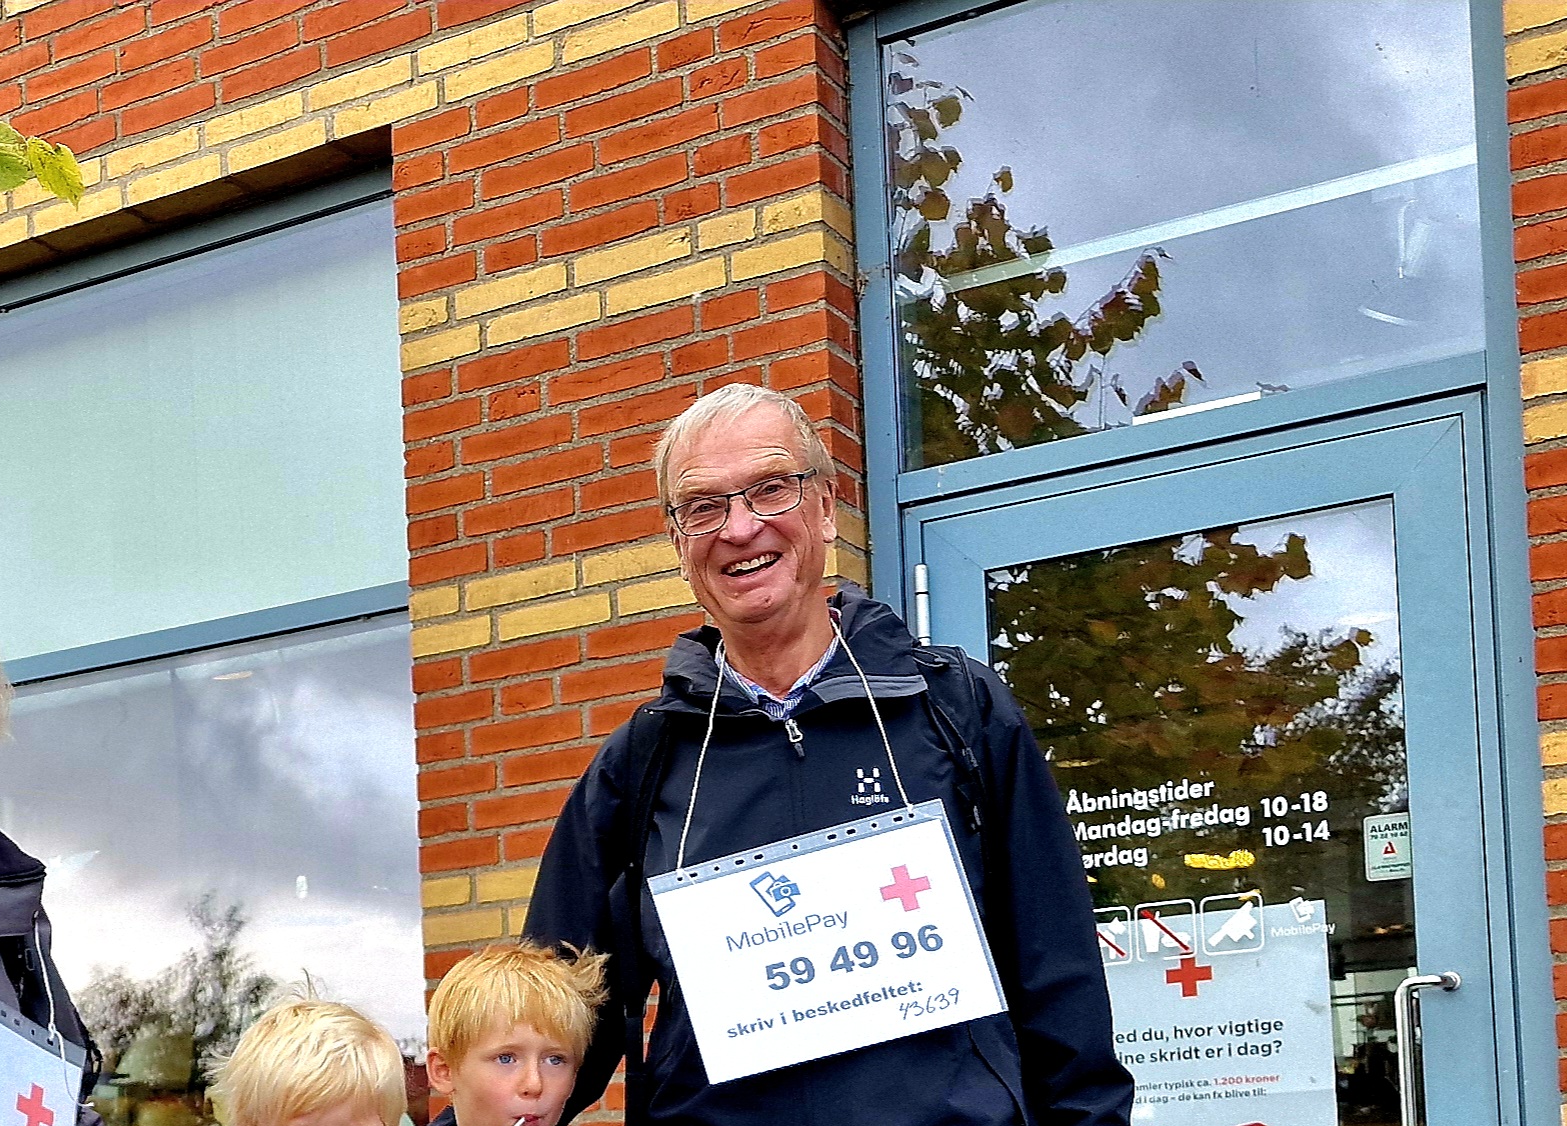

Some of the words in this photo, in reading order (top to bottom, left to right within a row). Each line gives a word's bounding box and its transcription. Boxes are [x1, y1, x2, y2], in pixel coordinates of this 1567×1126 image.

[1065, 778, 1214, 815] Åbningstider
[1071, 803, 1251, 842] Mandag-fredag
[1370, 821, 1408, 833] ALARM
[1081, 844, 1148, 870] ørdag
[725, 909, 849, 953] MobilePay
[1270, 922, 1337, 938] MobilePay
[764, 955, 817, 992] 59
[828, 940, 880, 975] 49
[890, 923, 945, 960] 96
[725, 1012, 776, 1040] skriv
[779, 1010, 789, 1026] i
[791, 979, 925, 1023] beskedfeltet:
[1115, 1029, 1137, 1044] ed
[1141, 1027, 1170, 1043] du,
[1173, 1024, 1213, 1040] hvor
[1217, 1018, 1284, 1037] vigtige
[1118, 1051, 1146, 1066] ine
[1149, 1046, 1201, 1063] skridt
[1205, 1046, 1224, 1060] er
[1227, 1042, 1233, 1058] i
[1236, 1039, 1284, 1058] dag?
[1164, 1079, 1195, 1091] typisk
[1196, 1078, 1212, 1088] ca.
[1213, 1076, 1243, 1086] 1.200
[1244, 1074, 1281, 1085] kroner
[1192, 1091, 1211, 1101] kan
[1224, 1088, 1251, 1099] blive
